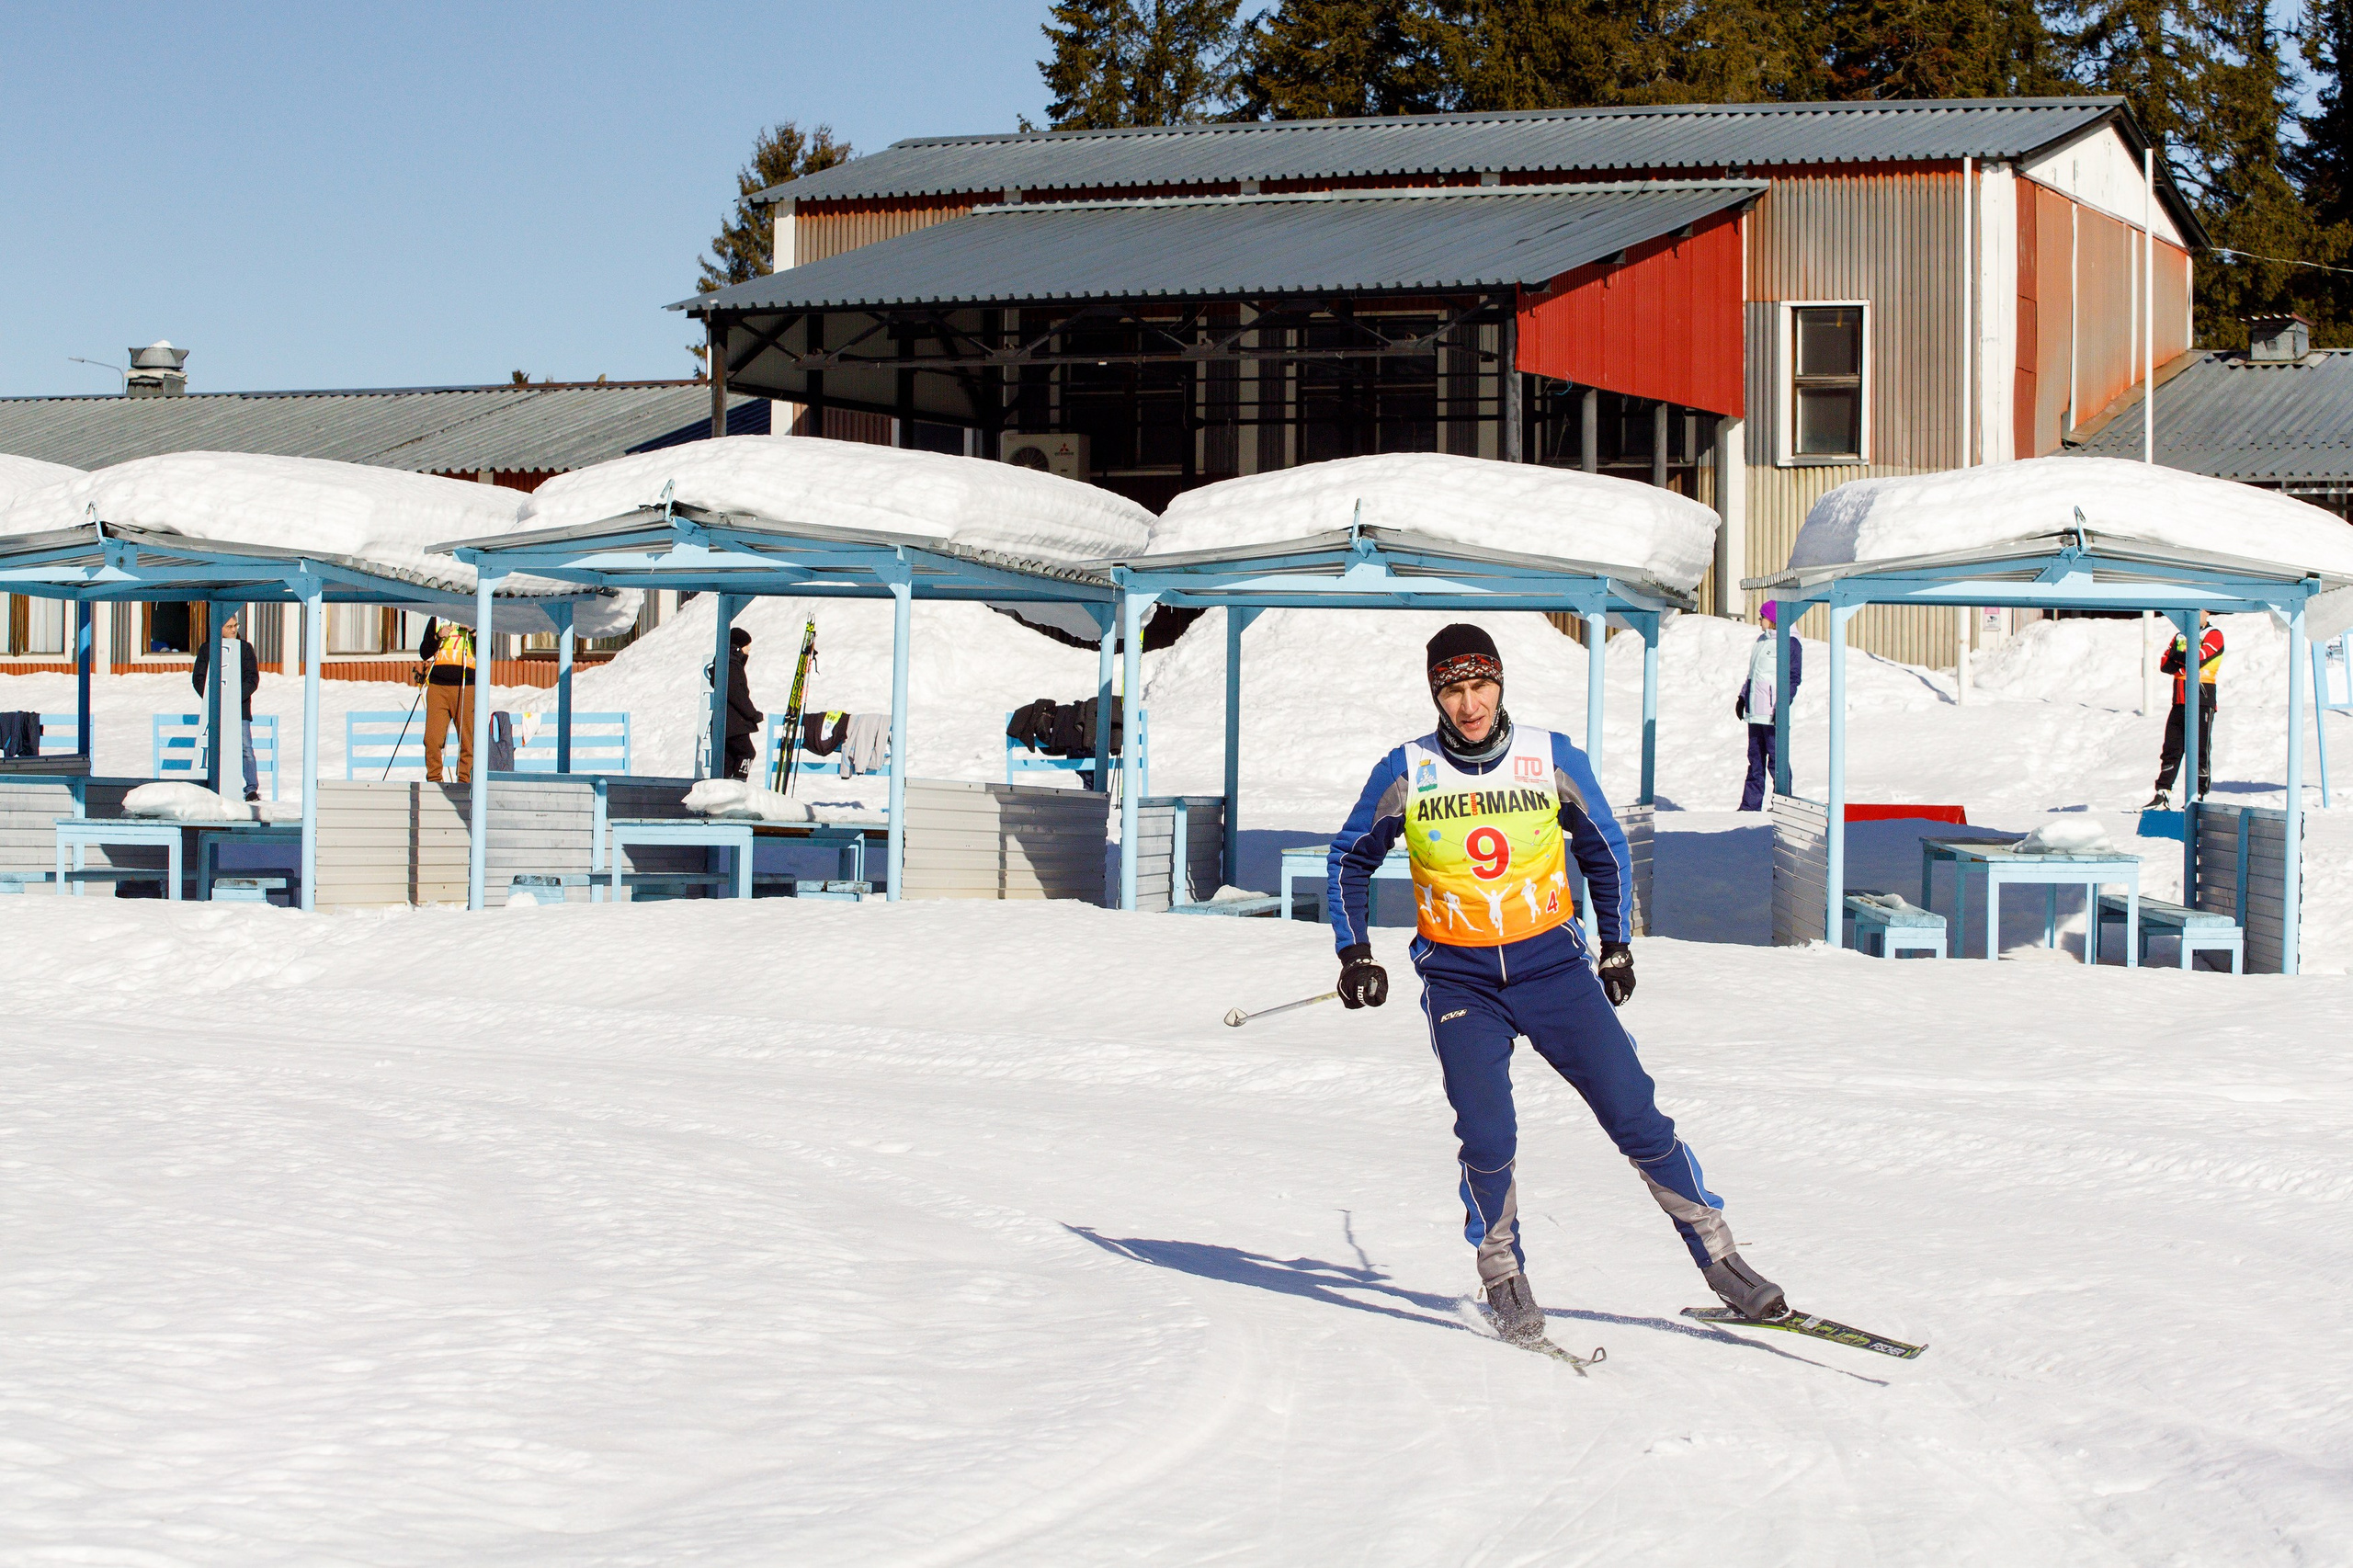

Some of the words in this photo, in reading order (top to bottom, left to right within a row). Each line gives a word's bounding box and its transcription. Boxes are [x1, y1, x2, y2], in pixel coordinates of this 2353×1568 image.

[1417, 789, 1551, 822] AKKERMANN
[1465, 826, 1510, 881] 9
[1546, 890, 1558, 913] 4
